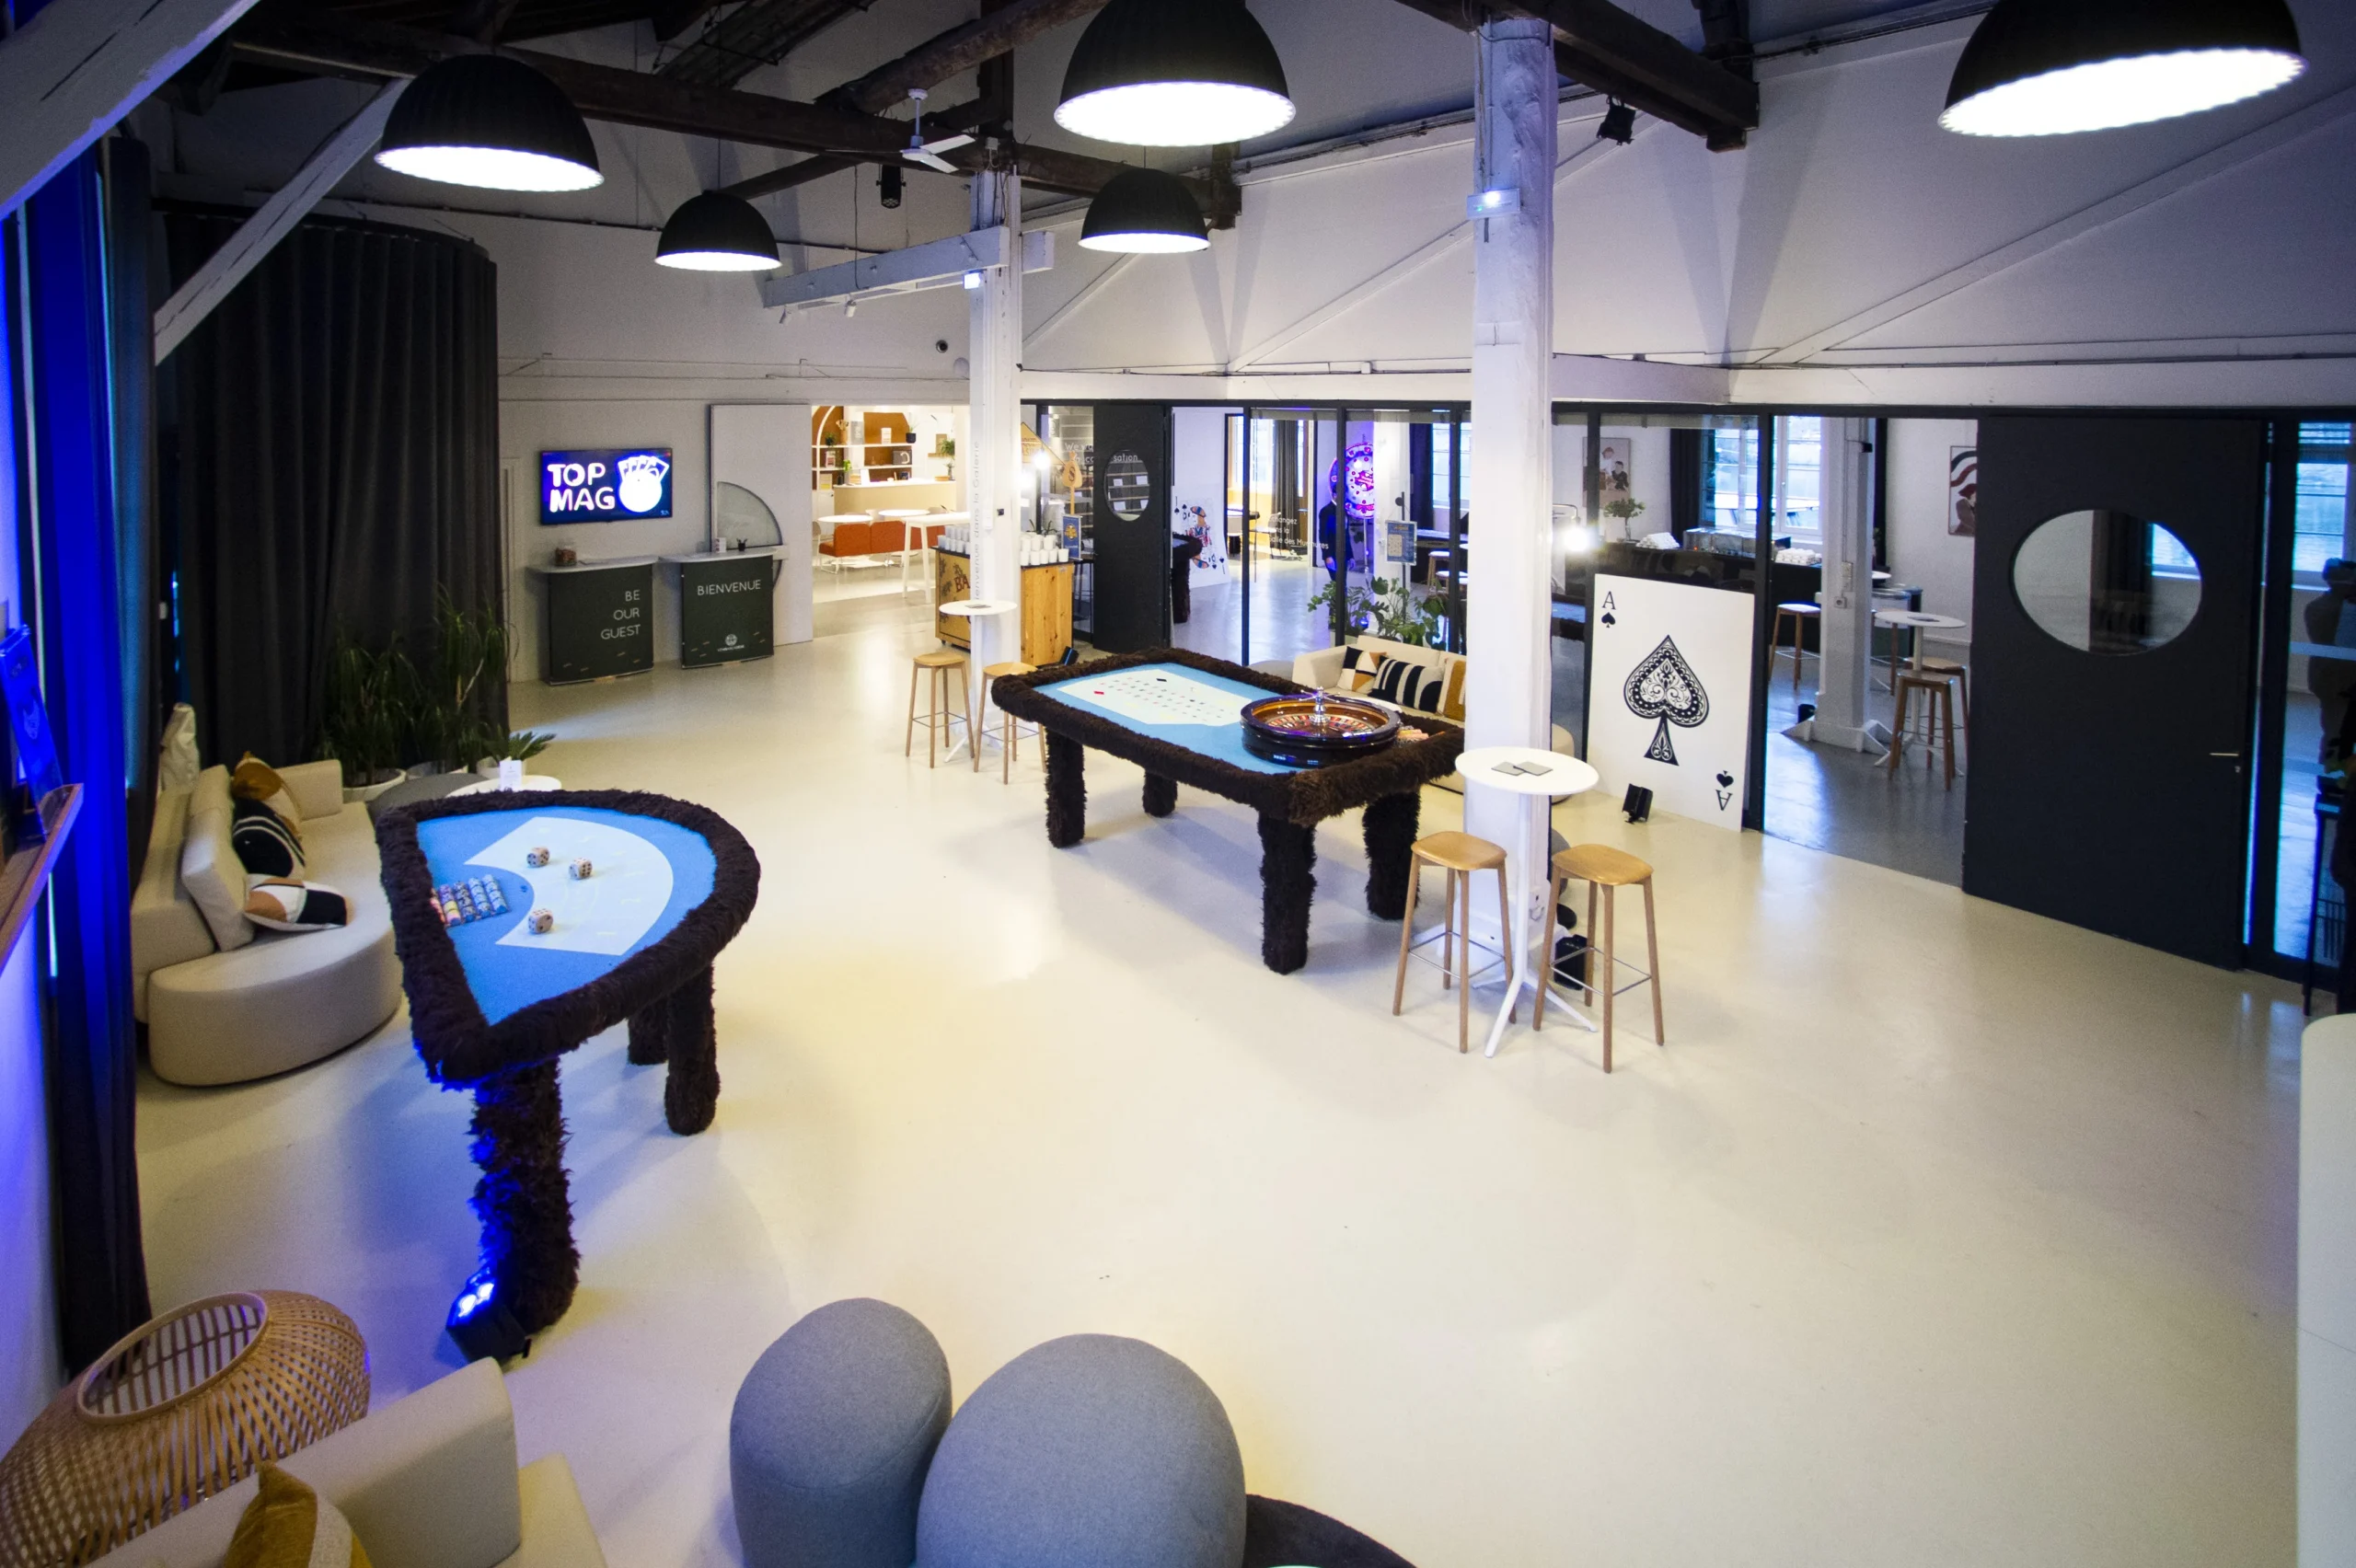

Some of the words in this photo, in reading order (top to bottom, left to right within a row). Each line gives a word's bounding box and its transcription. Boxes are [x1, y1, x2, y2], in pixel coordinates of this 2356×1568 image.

[547, 463, 606, 487] TOP
[549, 487, 615, 513] MAG
[973, 493, 979, 503] la
[1297, 538, 1329, 549] Murures
[625, 590, 641, 602] BE
[697, 580, 761, 596] BIENVENUE
[1601, 591, 1616, 610] A
[613, 607, 641, 621] OUR
[600, 624, 641, 640] GUEST
[1715, 789, 1733, 812] A
